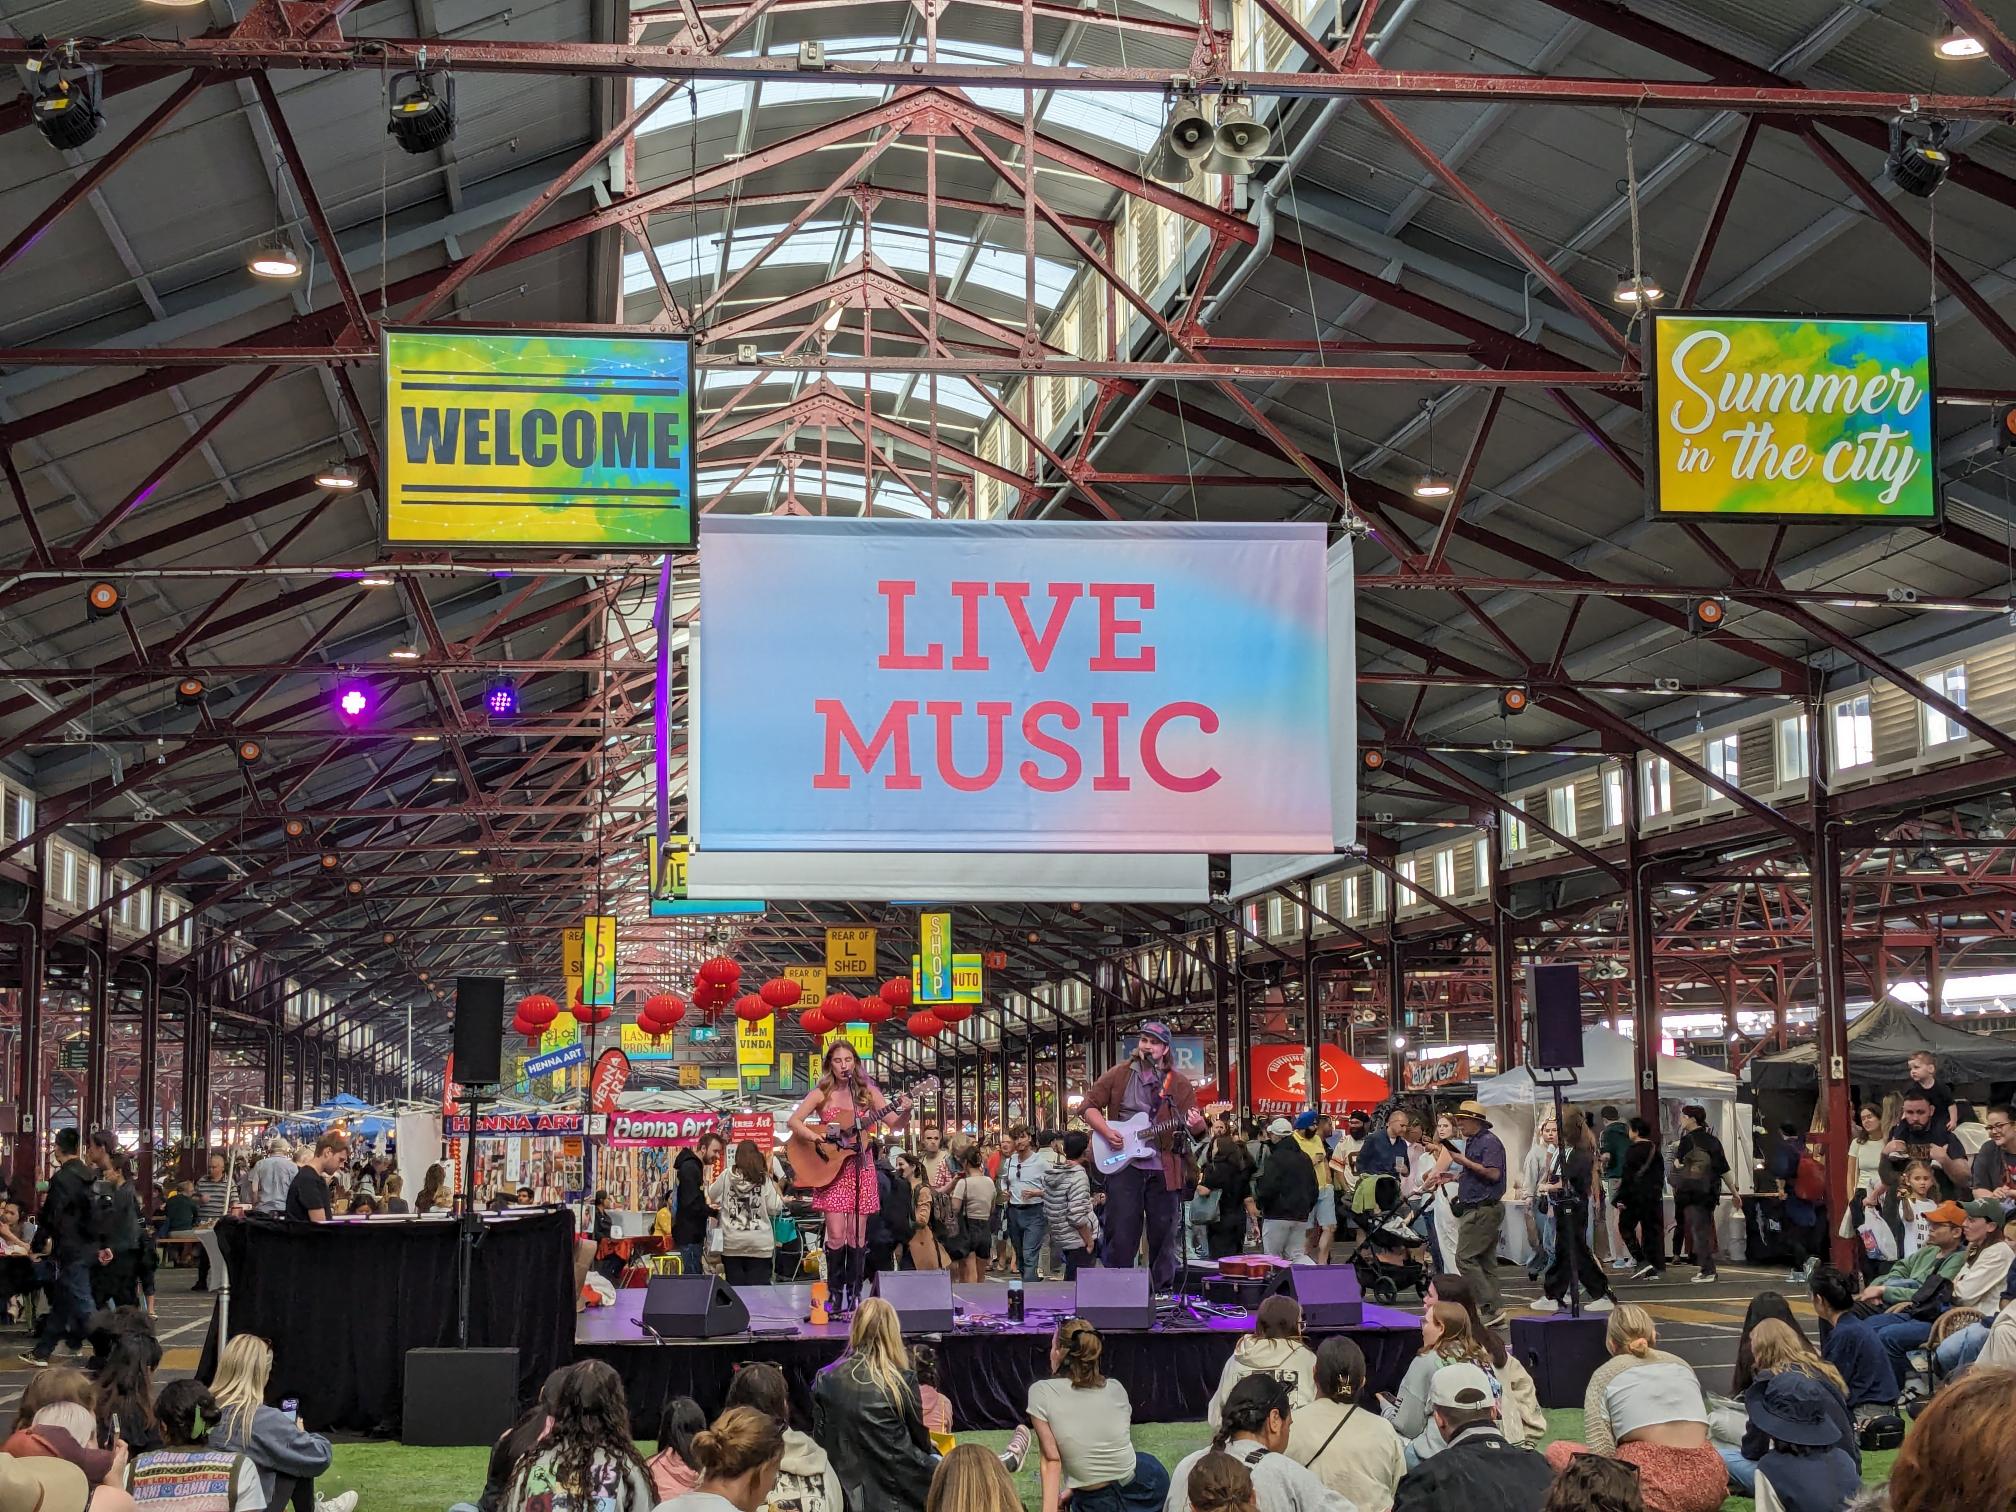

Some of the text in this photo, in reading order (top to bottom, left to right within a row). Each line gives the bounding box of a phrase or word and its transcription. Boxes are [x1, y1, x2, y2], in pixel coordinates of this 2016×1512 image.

[1670, 330, 1922, 435] Summer
[401, 406, 681, 469] WELCOME
[1677, 422, 1921, 504] in the city
[878, 580, 1155, 672] LIVE
[813, 700, 1222, 793] MUSIC
[831, 930, 870, 941] REAR OF
[845, 942, 857, 957] L
[931, 915, 943, 996] SHOP
[789, 969, 822, 978] REAR OF
[834, 960, 867, 972] SHED
[801, 979, 811, 991] L
[799, 994, 820, 1005] HED
[740, 1040, 772, 1049] VINDA
[528, 1056, 563, 1074] HENNA
[564, 1048, 582, 1062] ART
[593, 1057, 621, 1109] HENNA
[609, 1070, 626, 1105] ART
[1258, 1098, 1291, 1113] Run
[1335, 1099, 1348, 1114] it
[538, 1114, 584, 1131] ART
[613, 1117, 714, 1138] Henna Art
[182, 1474, 208, 1483] LOVE
